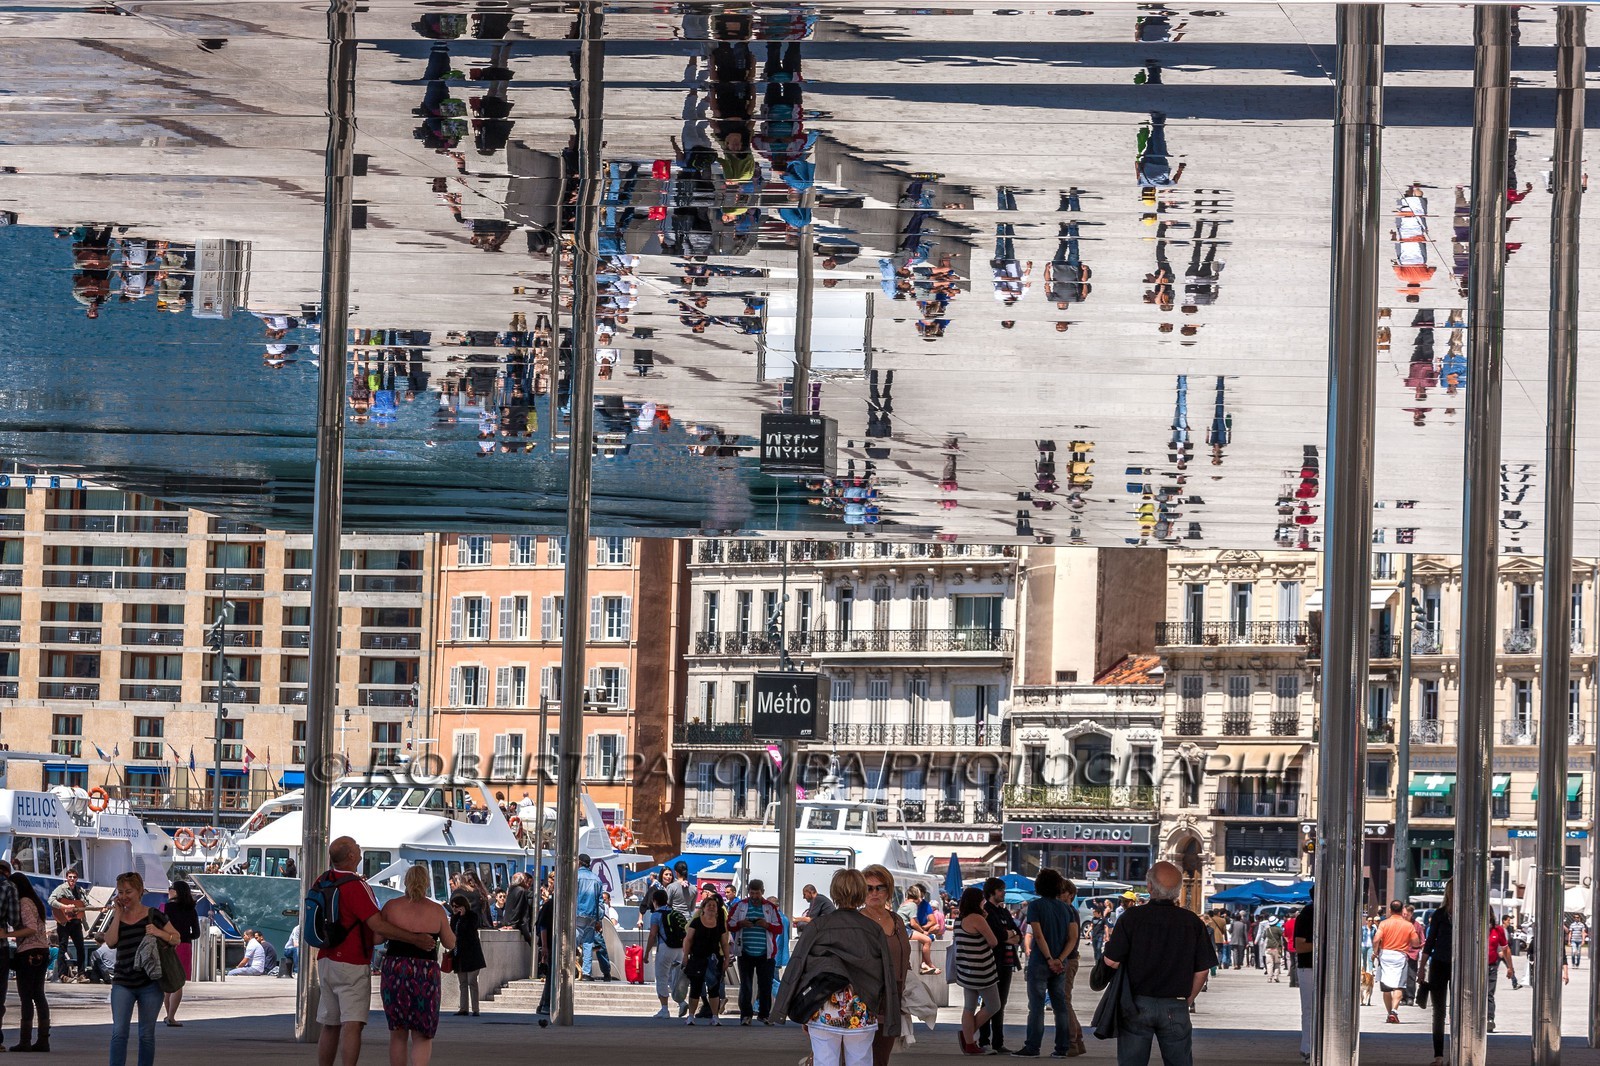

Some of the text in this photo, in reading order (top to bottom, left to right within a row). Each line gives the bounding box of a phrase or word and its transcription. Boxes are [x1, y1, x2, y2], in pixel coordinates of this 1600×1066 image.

[757, 691, 811, 715] Métro
[17, 796, 57, 817] HELIOS
[915, 831, 985, 842] MIRAMAR
[1021, 824, 1133, 840] Le Petit Pernod
[1233, 855, 1287, 867] DESSANG
